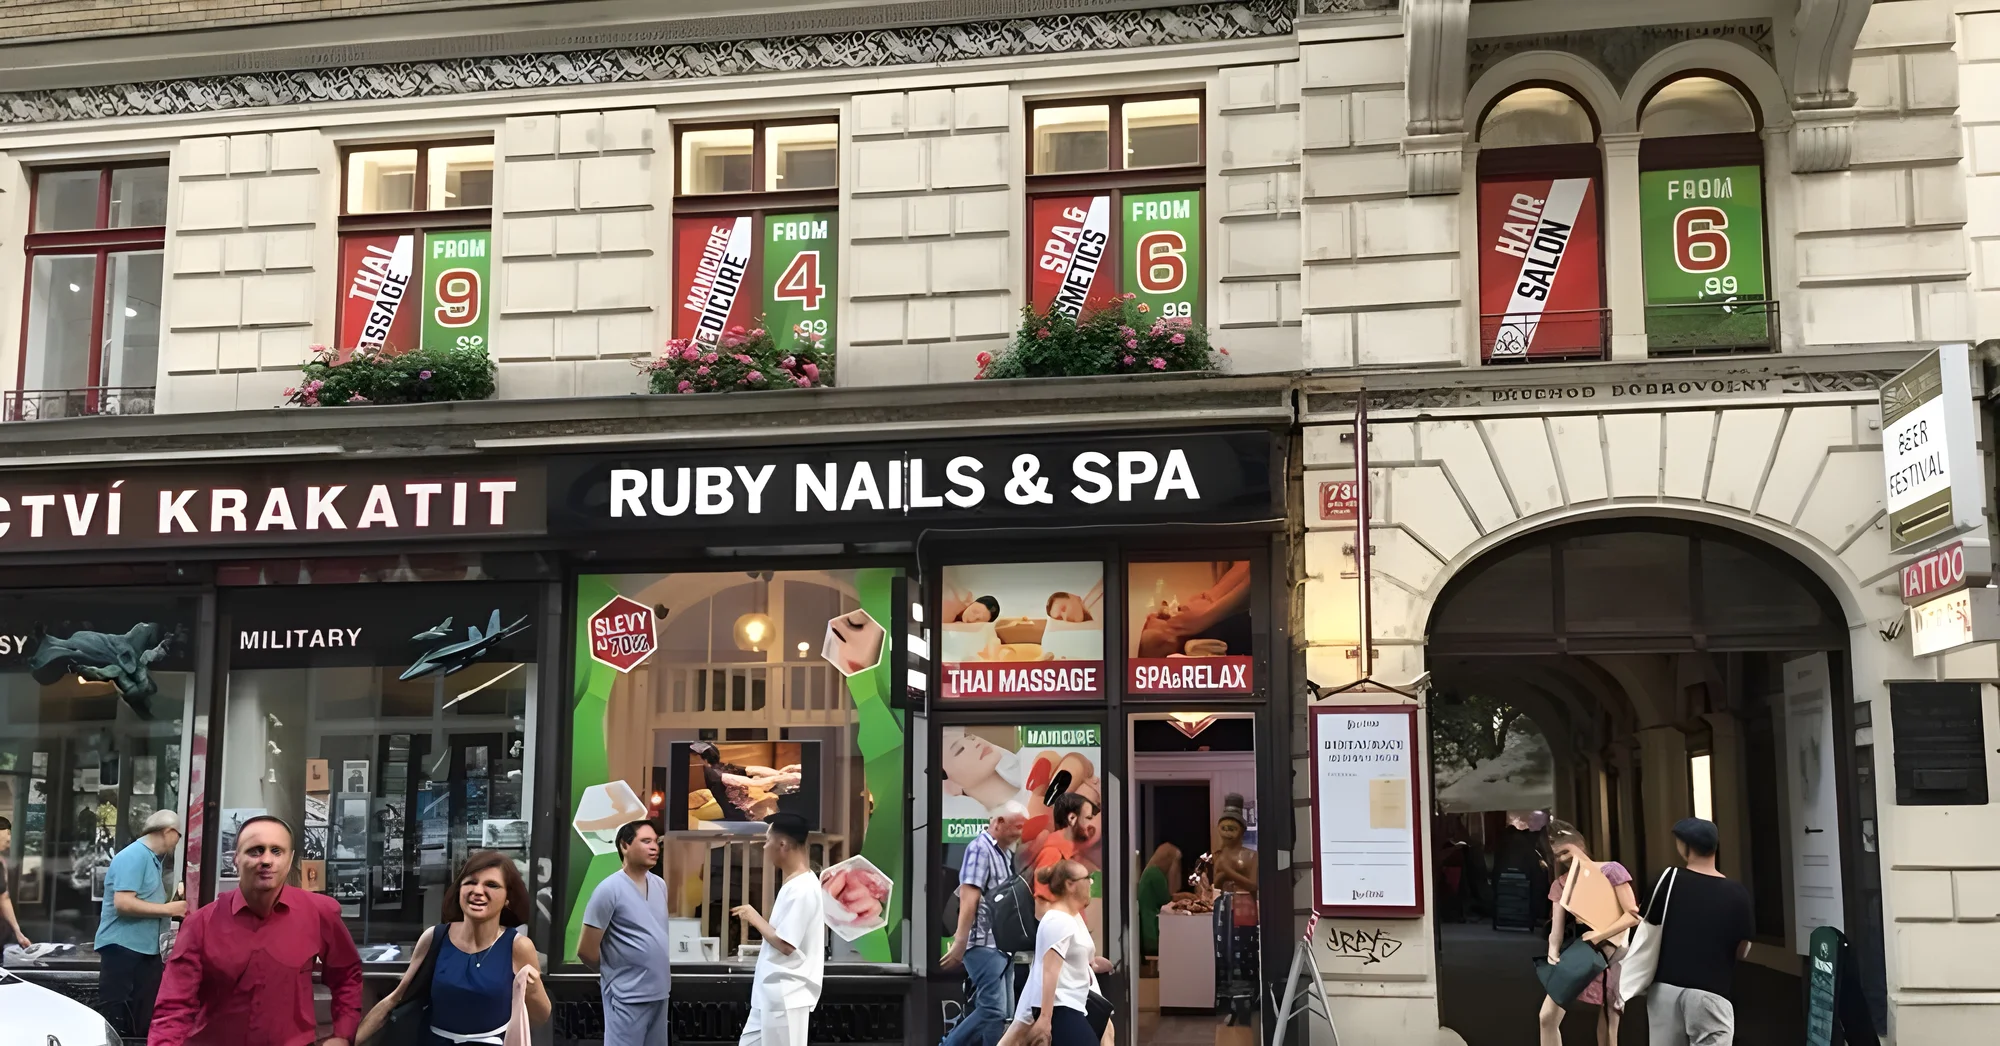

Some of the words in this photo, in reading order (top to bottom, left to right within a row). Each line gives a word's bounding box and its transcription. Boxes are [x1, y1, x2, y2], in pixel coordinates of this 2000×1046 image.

[1132, 200, 1190, 221] FROM
[1668, 177, 1733, 200] FROM
[433, 239, 486, 259] FROM
[773, 221, 827, 241] FROM
[1039, 226, 1082, 274] SPA
[1494, 193, 1545, 259] HAIR
[1673, 205, 1731, 274] 6
[349, 244, 394, 301] THAI
[684, 226, 731, 312] MANICURE
[774, 250, 825, 311] 4
[1136, 230, 1187, 294] 6
[1517, 219, 1571, 302] SALON
[361, 270, 408, 350] SSAGE
[434, 268, 481, 328] 9
[694, 253, 747, 347] EDICURE
[1899, 419, 1929, 455] BEER
[610, 464, 776, 518] RUBY
[795, 455, 986, 513] NAILS
[1005, 453, 1054, 505] &
[1071, 448, 1200, 504] SPA
[1890, 451, 1944, 498] FESTIVAL
[0, 479, 125, 539] TVÍ
[157, 481, 517, 534] KRAKATIT
[1903, 549, 1965, 598] TATTOO
[240, 627, 363, 650] MILITARY
[594, 611, 647, 636] SLEVY
[949, 670, 993, 693] THAI
[999, 668, 1097, 693] MASSAGE
